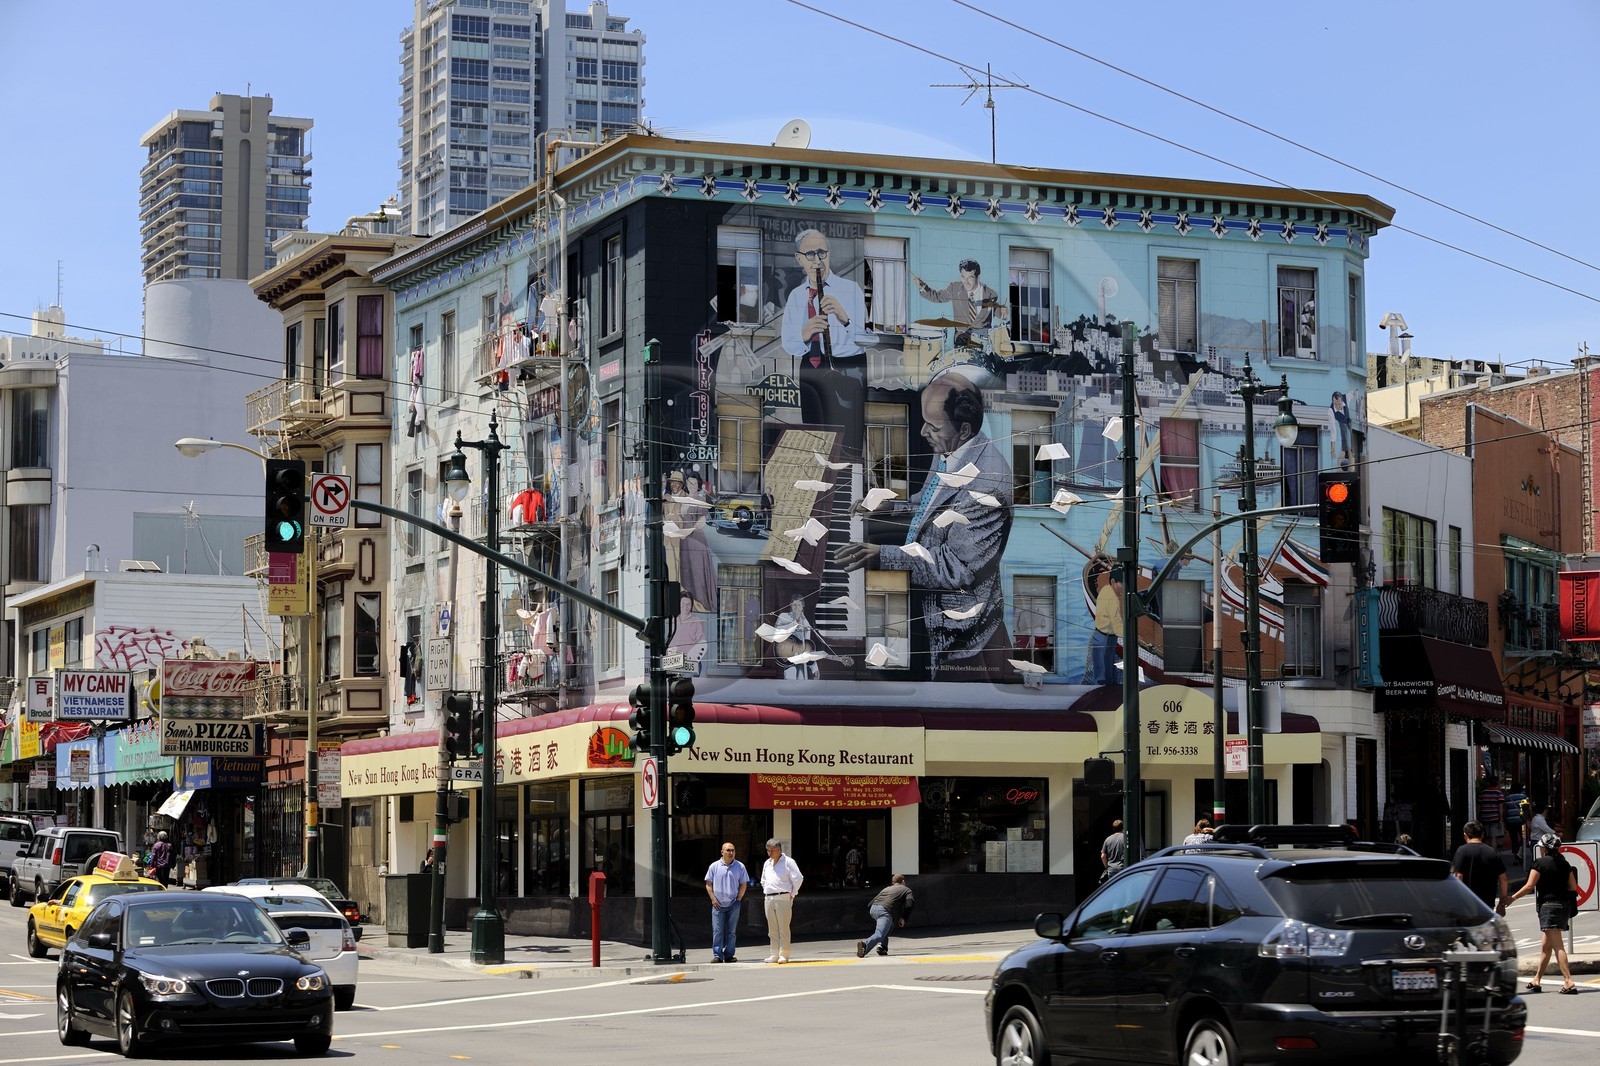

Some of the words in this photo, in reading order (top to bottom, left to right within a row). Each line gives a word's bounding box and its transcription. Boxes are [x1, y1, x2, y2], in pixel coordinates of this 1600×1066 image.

[829, 223, 865, 238] HOTEL
[700, 336, 708, 388] MULIN
[700, 394, 708, 437] ROUGE
[313, 514, 325, 523] ON
[329, 516, 345, 525] RED
[1575, 576, 1586, 596] LIVE
[1575, 598, 1586, 636] WARHOL
[430, 643, 449, 655] RIGHT
[430, 658, 449, 670] TURN
[663, 656, 681, 667] BROADWAY
[64, 673, 85, 692] MY
[86, 674, 126, 693] CANH
[429, 674, 448, 685] ONLY
[35, 680, 49, 695] 百
[63, 696, 125, 706] VIETNAMESE
[1163, 700, 1183, 713] 606
[63, 706, 125, 716] RESTAURANT
[165, 720, 194, 738] Sam's
[195, 723, 253, 739] PIZZA
[1139, 719, 1215, 735] 香港酒家
[165, 744, 177, 752] BEER
[180, 740, 249, 752] HAMBURGERS
[1146, 746, 1161, 756] Tel.
[1163, 746, 1198, 756] 956-3338
[688, 747, 720, 762] New
[724, 747, 751, 762] Sun
[756, 748, 795, 767] Hong
[798, 749, 836, 767] Kong
[839, 749, 914, 765] Restaurant
[186, 756, 209, 777] Vietnam
[212, 757, 260, 771] Vietnam
[348, 769, 362, 786] New
[365, 768, 378, 785] Sun
[380, 766, 398, 785] Hong
[401, 764, 419, 784] Kong
[757, 774, 785, 788] Dragon
[812, 776, 841, 786] Chinese
[879, 776, 910, 786] Festival
[1006, 788, 1038, 804] Open
